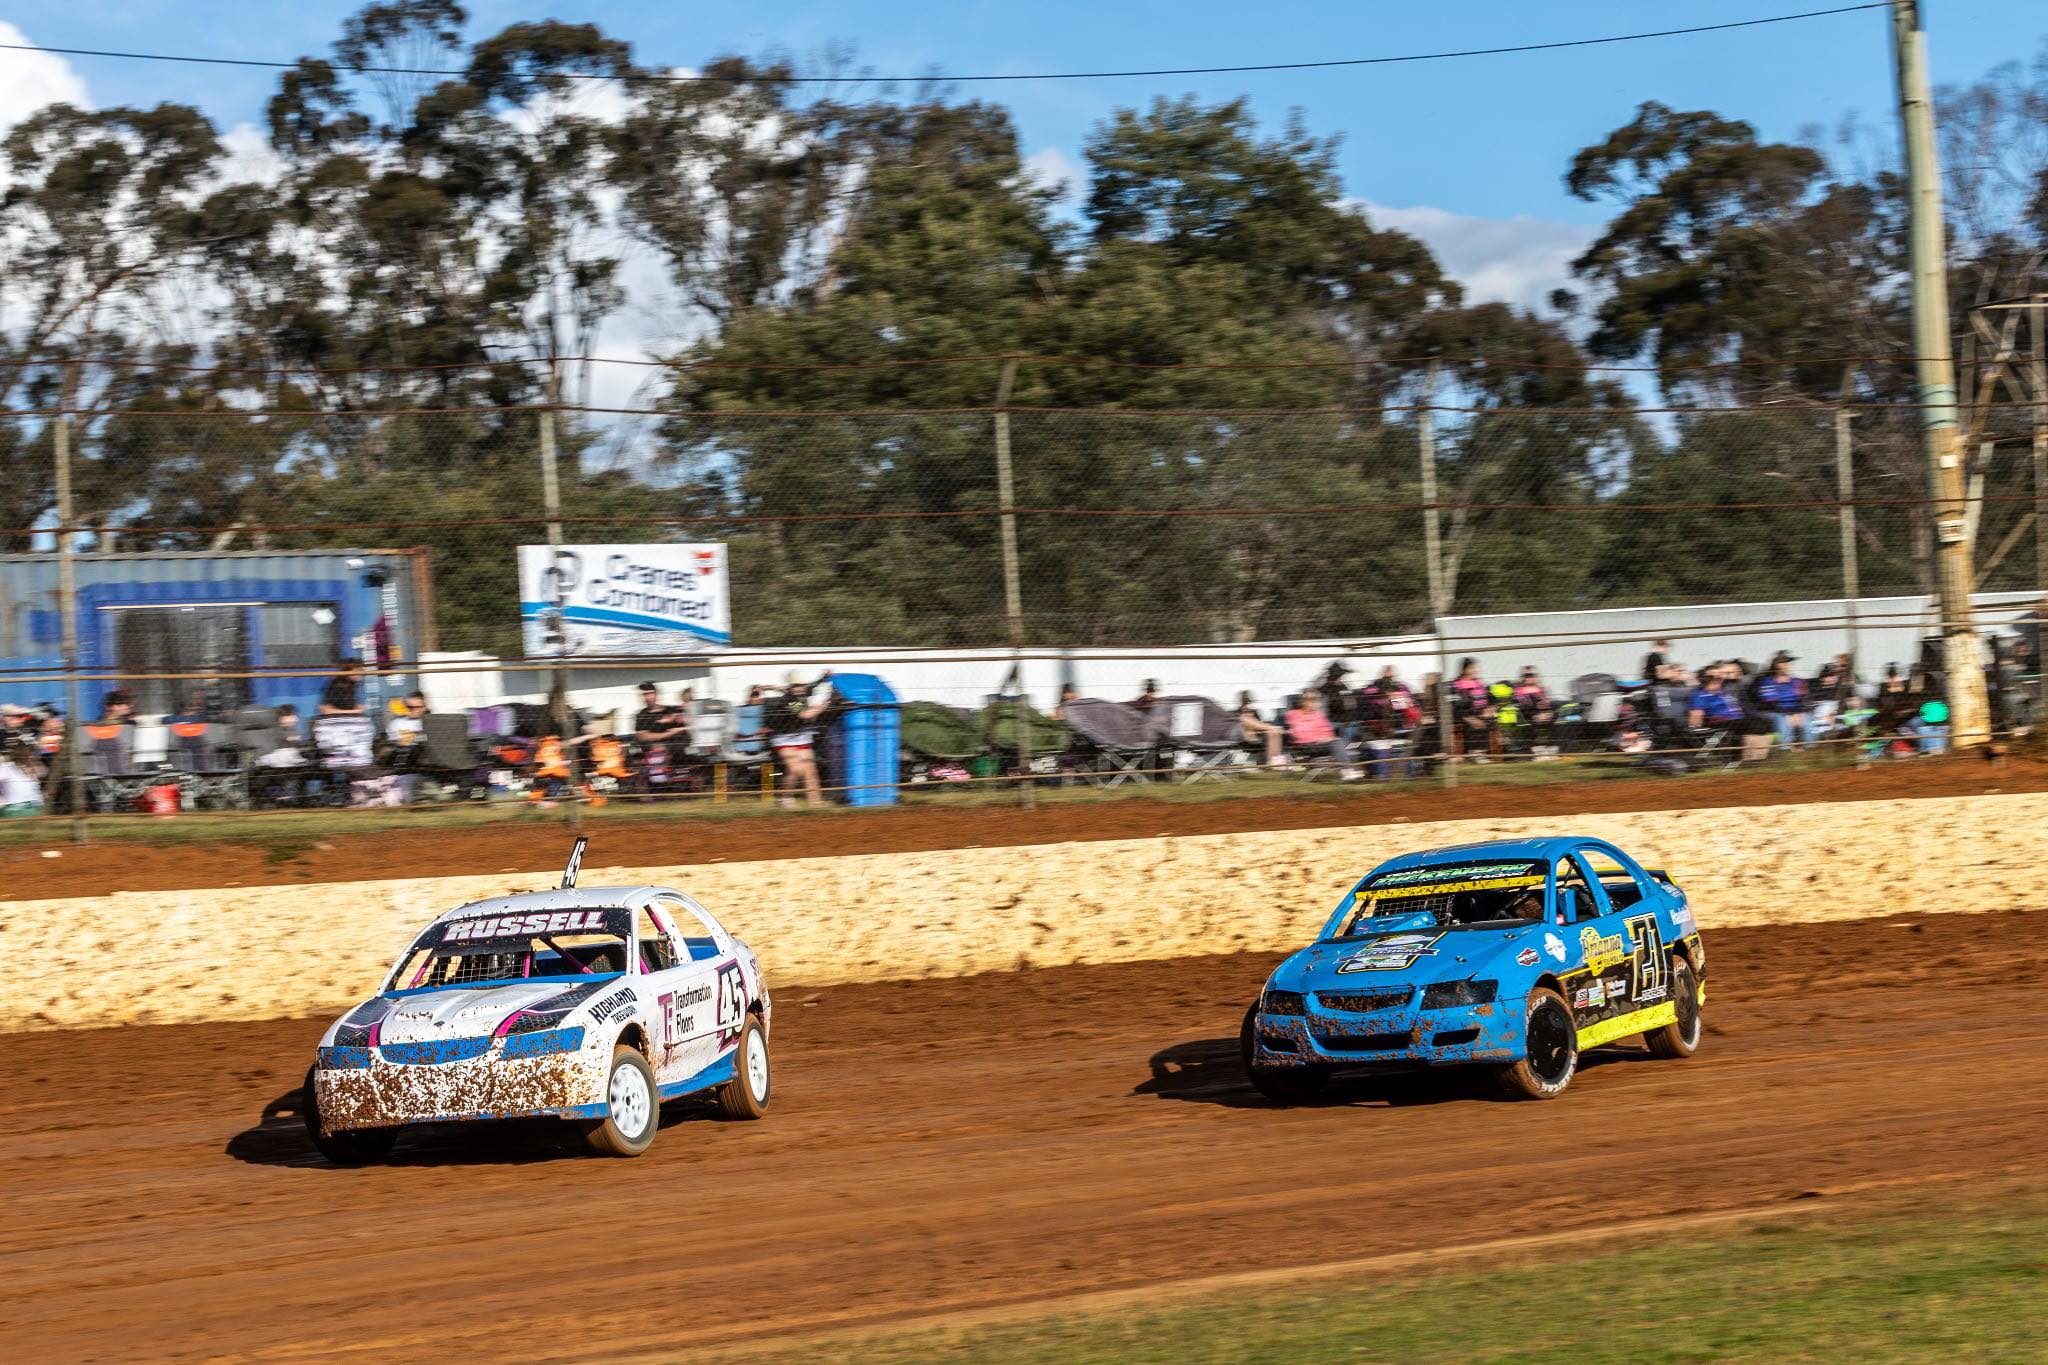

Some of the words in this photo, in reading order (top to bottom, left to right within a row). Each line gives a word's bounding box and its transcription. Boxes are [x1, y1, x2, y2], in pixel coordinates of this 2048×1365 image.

[607, 554, 699, 591] Cranes
[587, 578, 715, 620] Combined
[565, 840, 586, 886] 45
[442, 911, 606, 942] RUSSELL
[588, 987, 638, 1025] HIGHLAND
[674, 982, 713, 1011] Transformation
[717, 962, 748, 1044] 45
[676, 1012, 694, 1036] Floors
